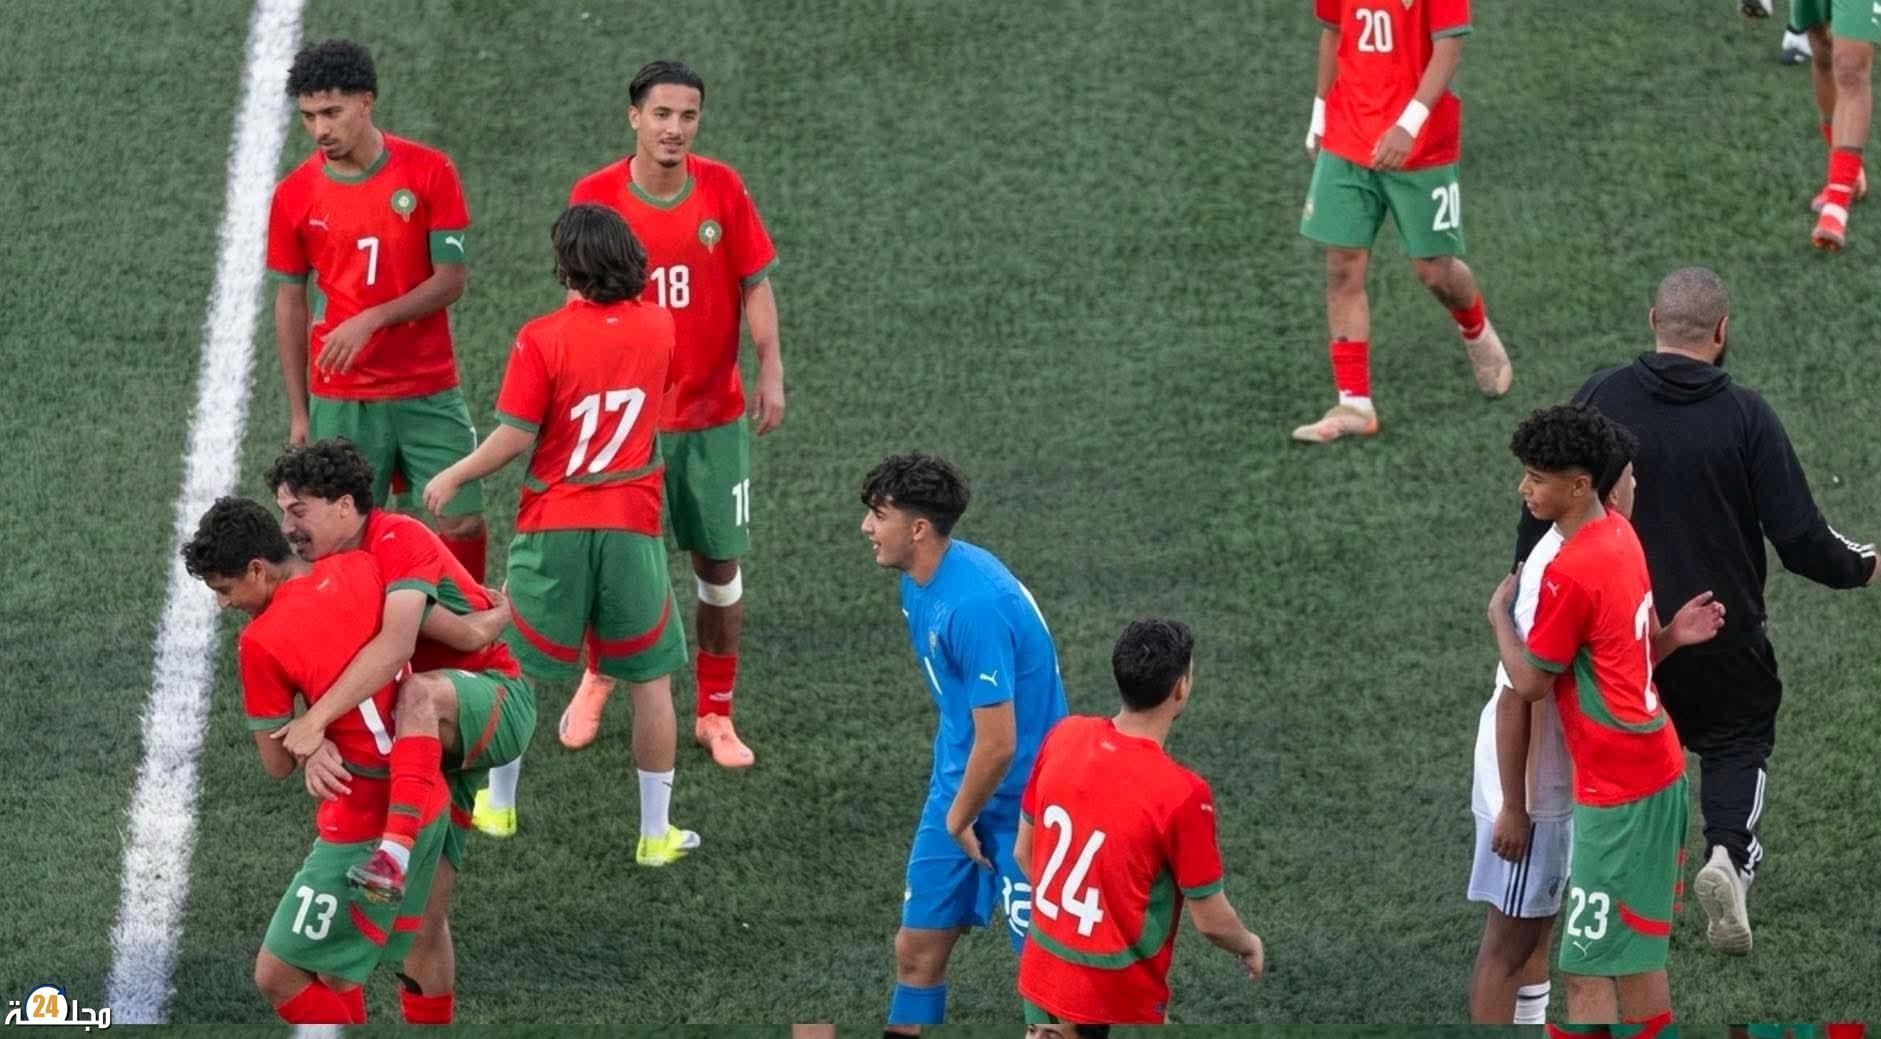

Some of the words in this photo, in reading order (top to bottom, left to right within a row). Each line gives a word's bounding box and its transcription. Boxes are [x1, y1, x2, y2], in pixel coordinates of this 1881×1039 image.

[1355, 8, 1393, 53] 20
[1431, 182, 1460, 231] 20
[357, 236, 379, 286] 7
[650, 264, 690, 310] 18
[566, 387, 646, 477] 17
[1034, 804, 1106, 937] 24
[292, 885, 337, 940] 13
[1567, 887, 1610, 940] 23
